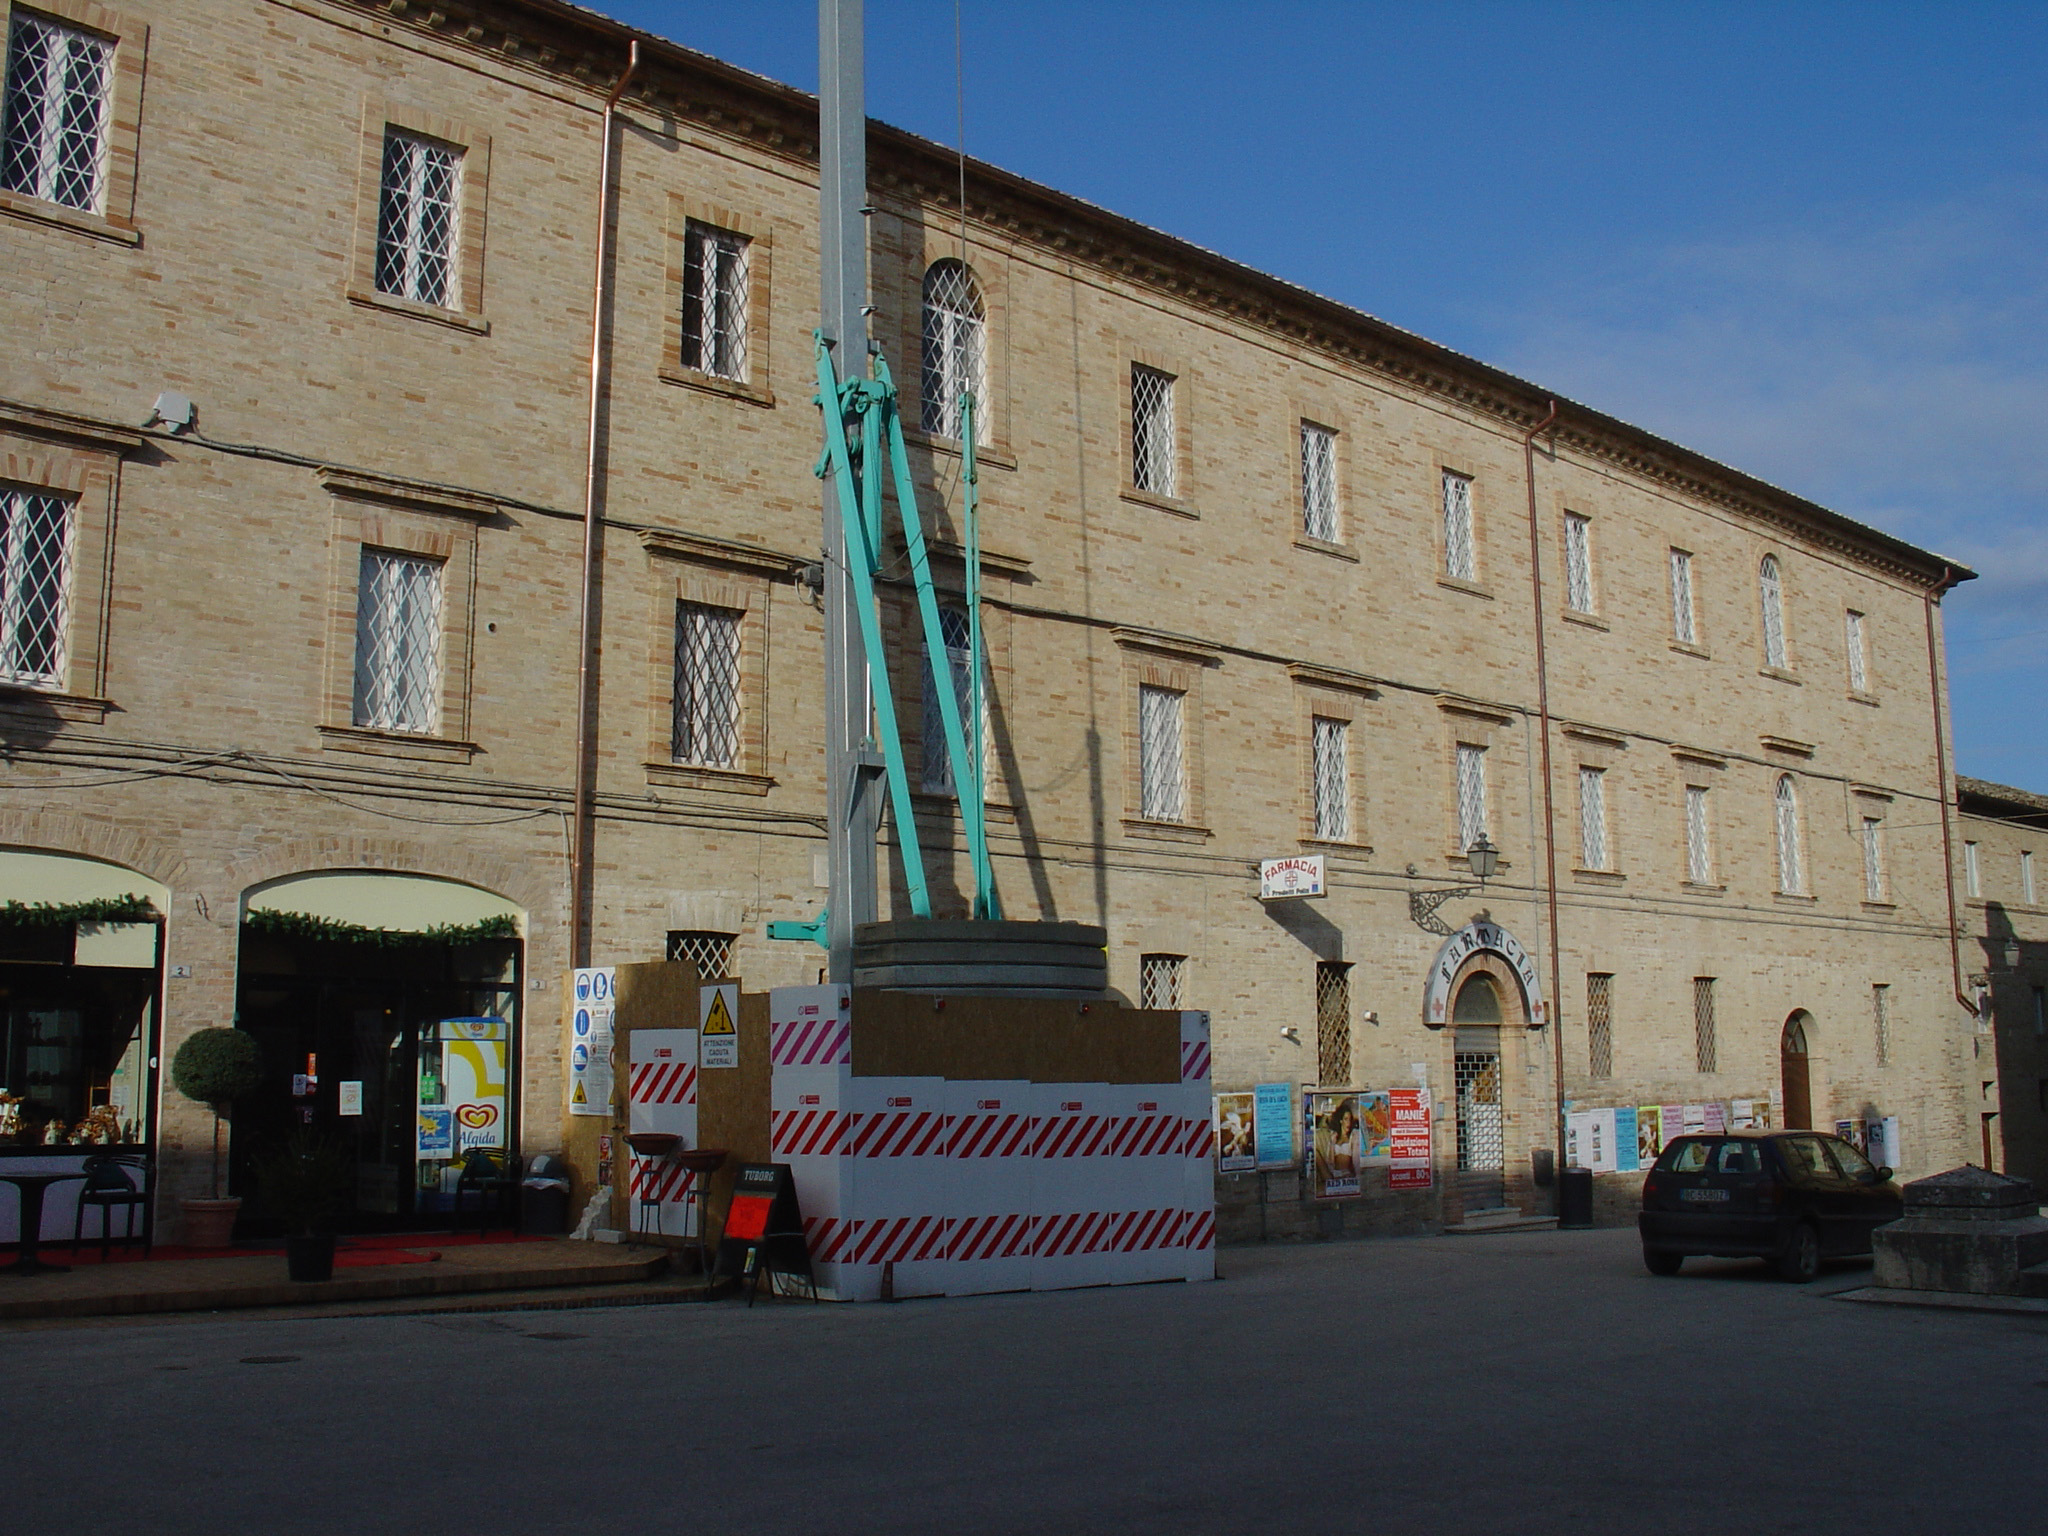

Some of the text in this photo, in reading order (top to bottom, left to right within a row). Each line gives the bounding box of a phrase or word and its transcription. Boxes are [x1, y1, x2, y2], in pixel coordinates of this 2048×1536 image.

[1264, 859, 1317, 881] FARMACIA
[1440, 928, 1535, 987] FARMACIA
[177, 966, 184, 975] 2
[703, 1039, 735, 1047] ATTENZIONE
[708, 1048, 729, 1056] CADUTA
[456, 1131, 496, 1148] Algida
[744, 1170, 775, 1182] TUBORG
